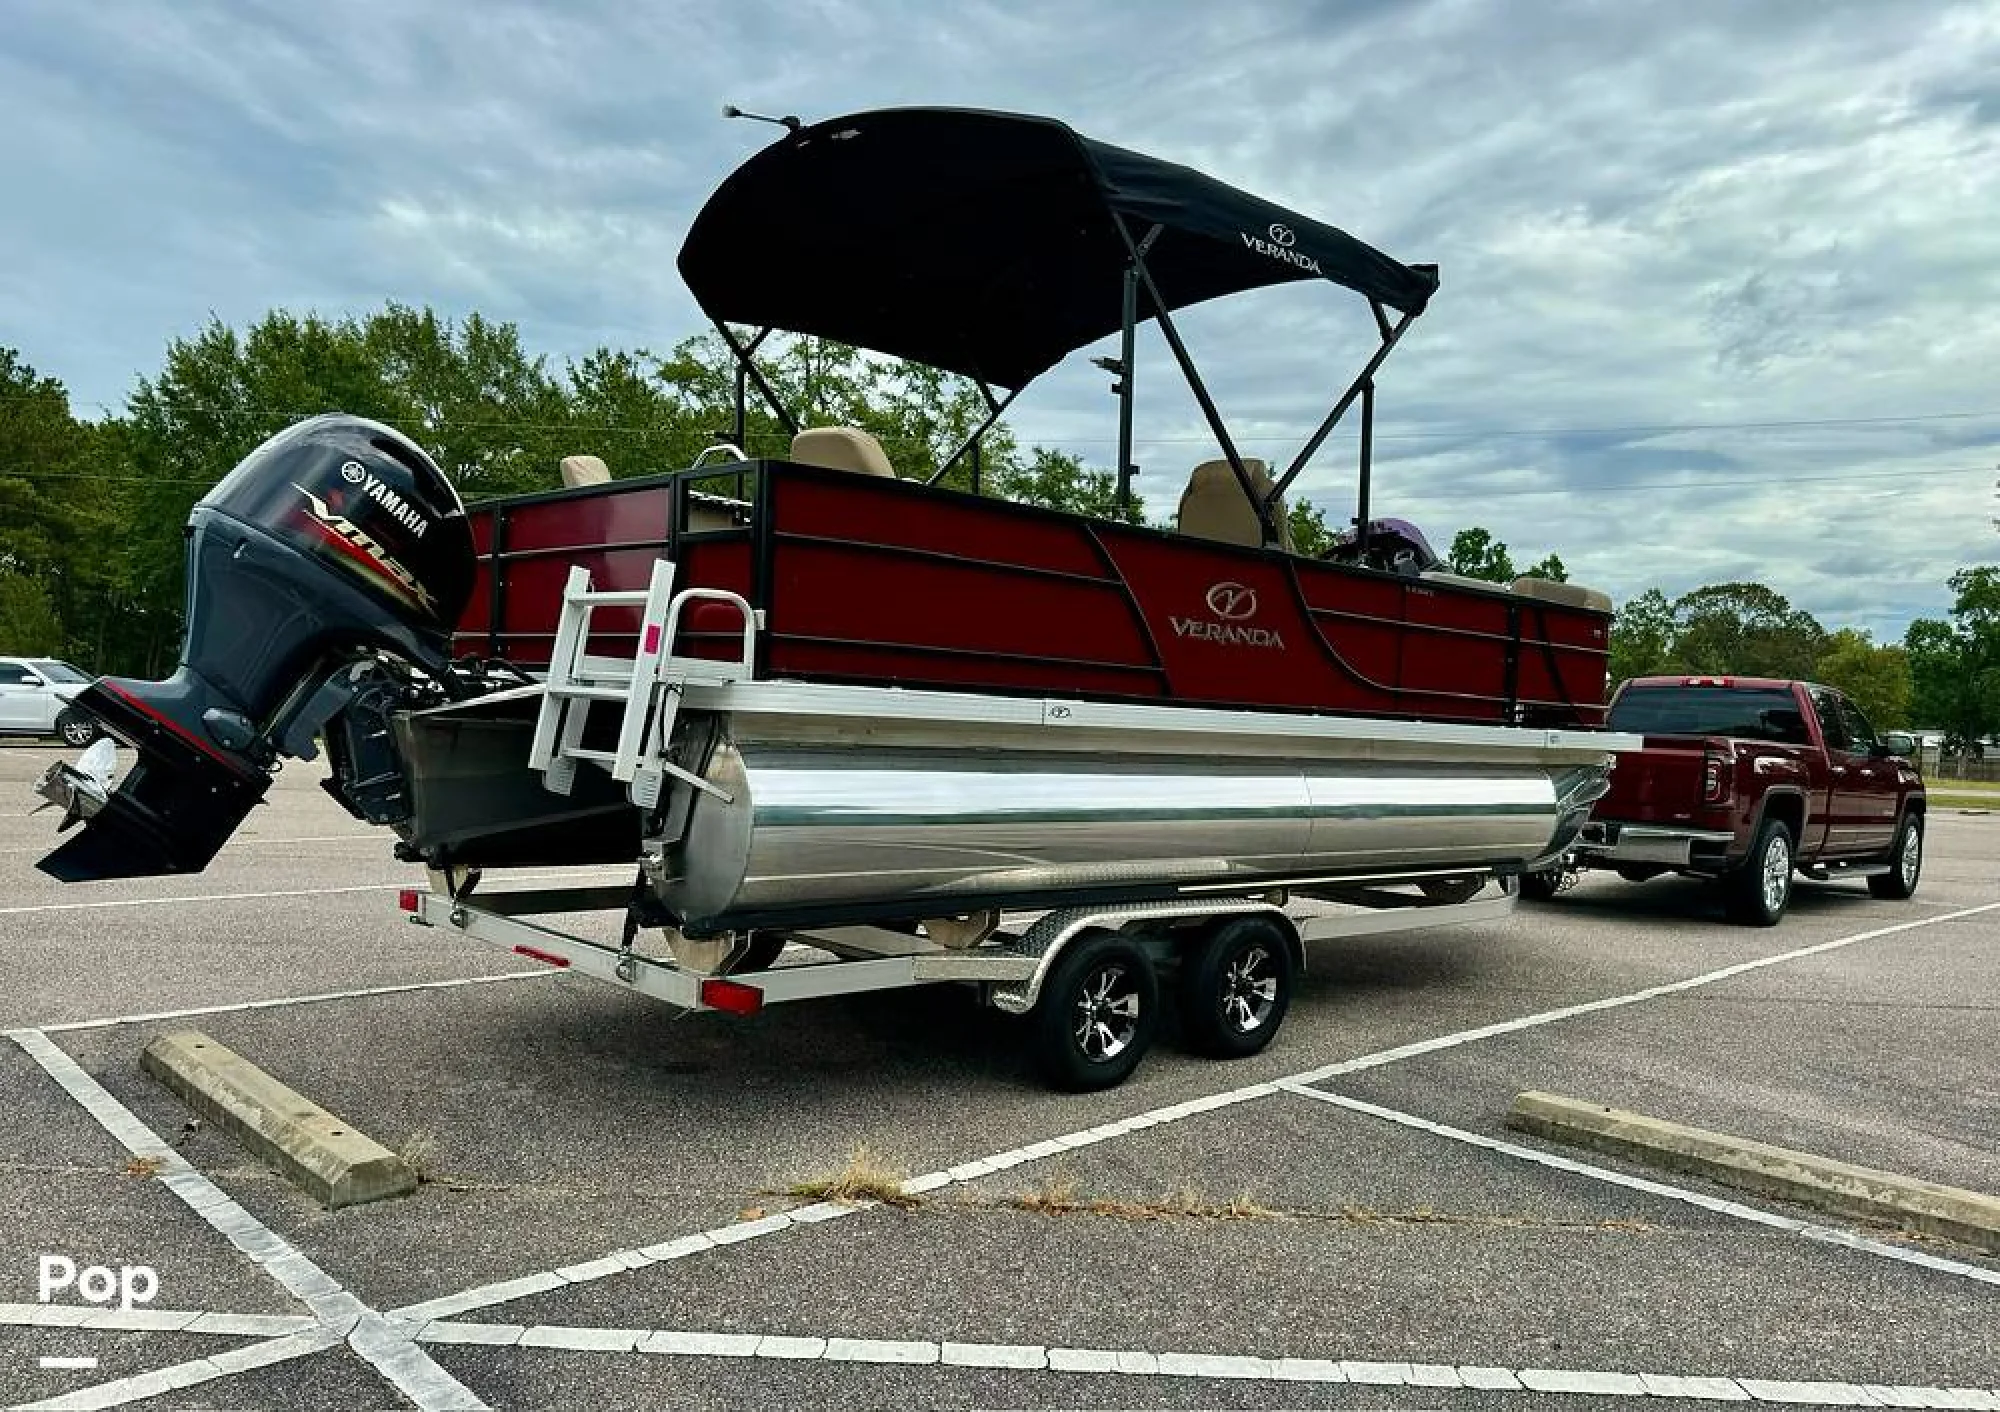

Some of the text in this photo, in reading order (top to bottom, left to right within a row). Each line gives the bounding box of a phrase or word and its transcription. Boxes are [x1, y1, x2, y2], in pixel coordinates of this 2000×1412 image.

[1242, 234, 1321, 274] VERANDA
[362, 474, 429, 538] YAMAHA
[1168, 616, 1285, 650] VERANDA
